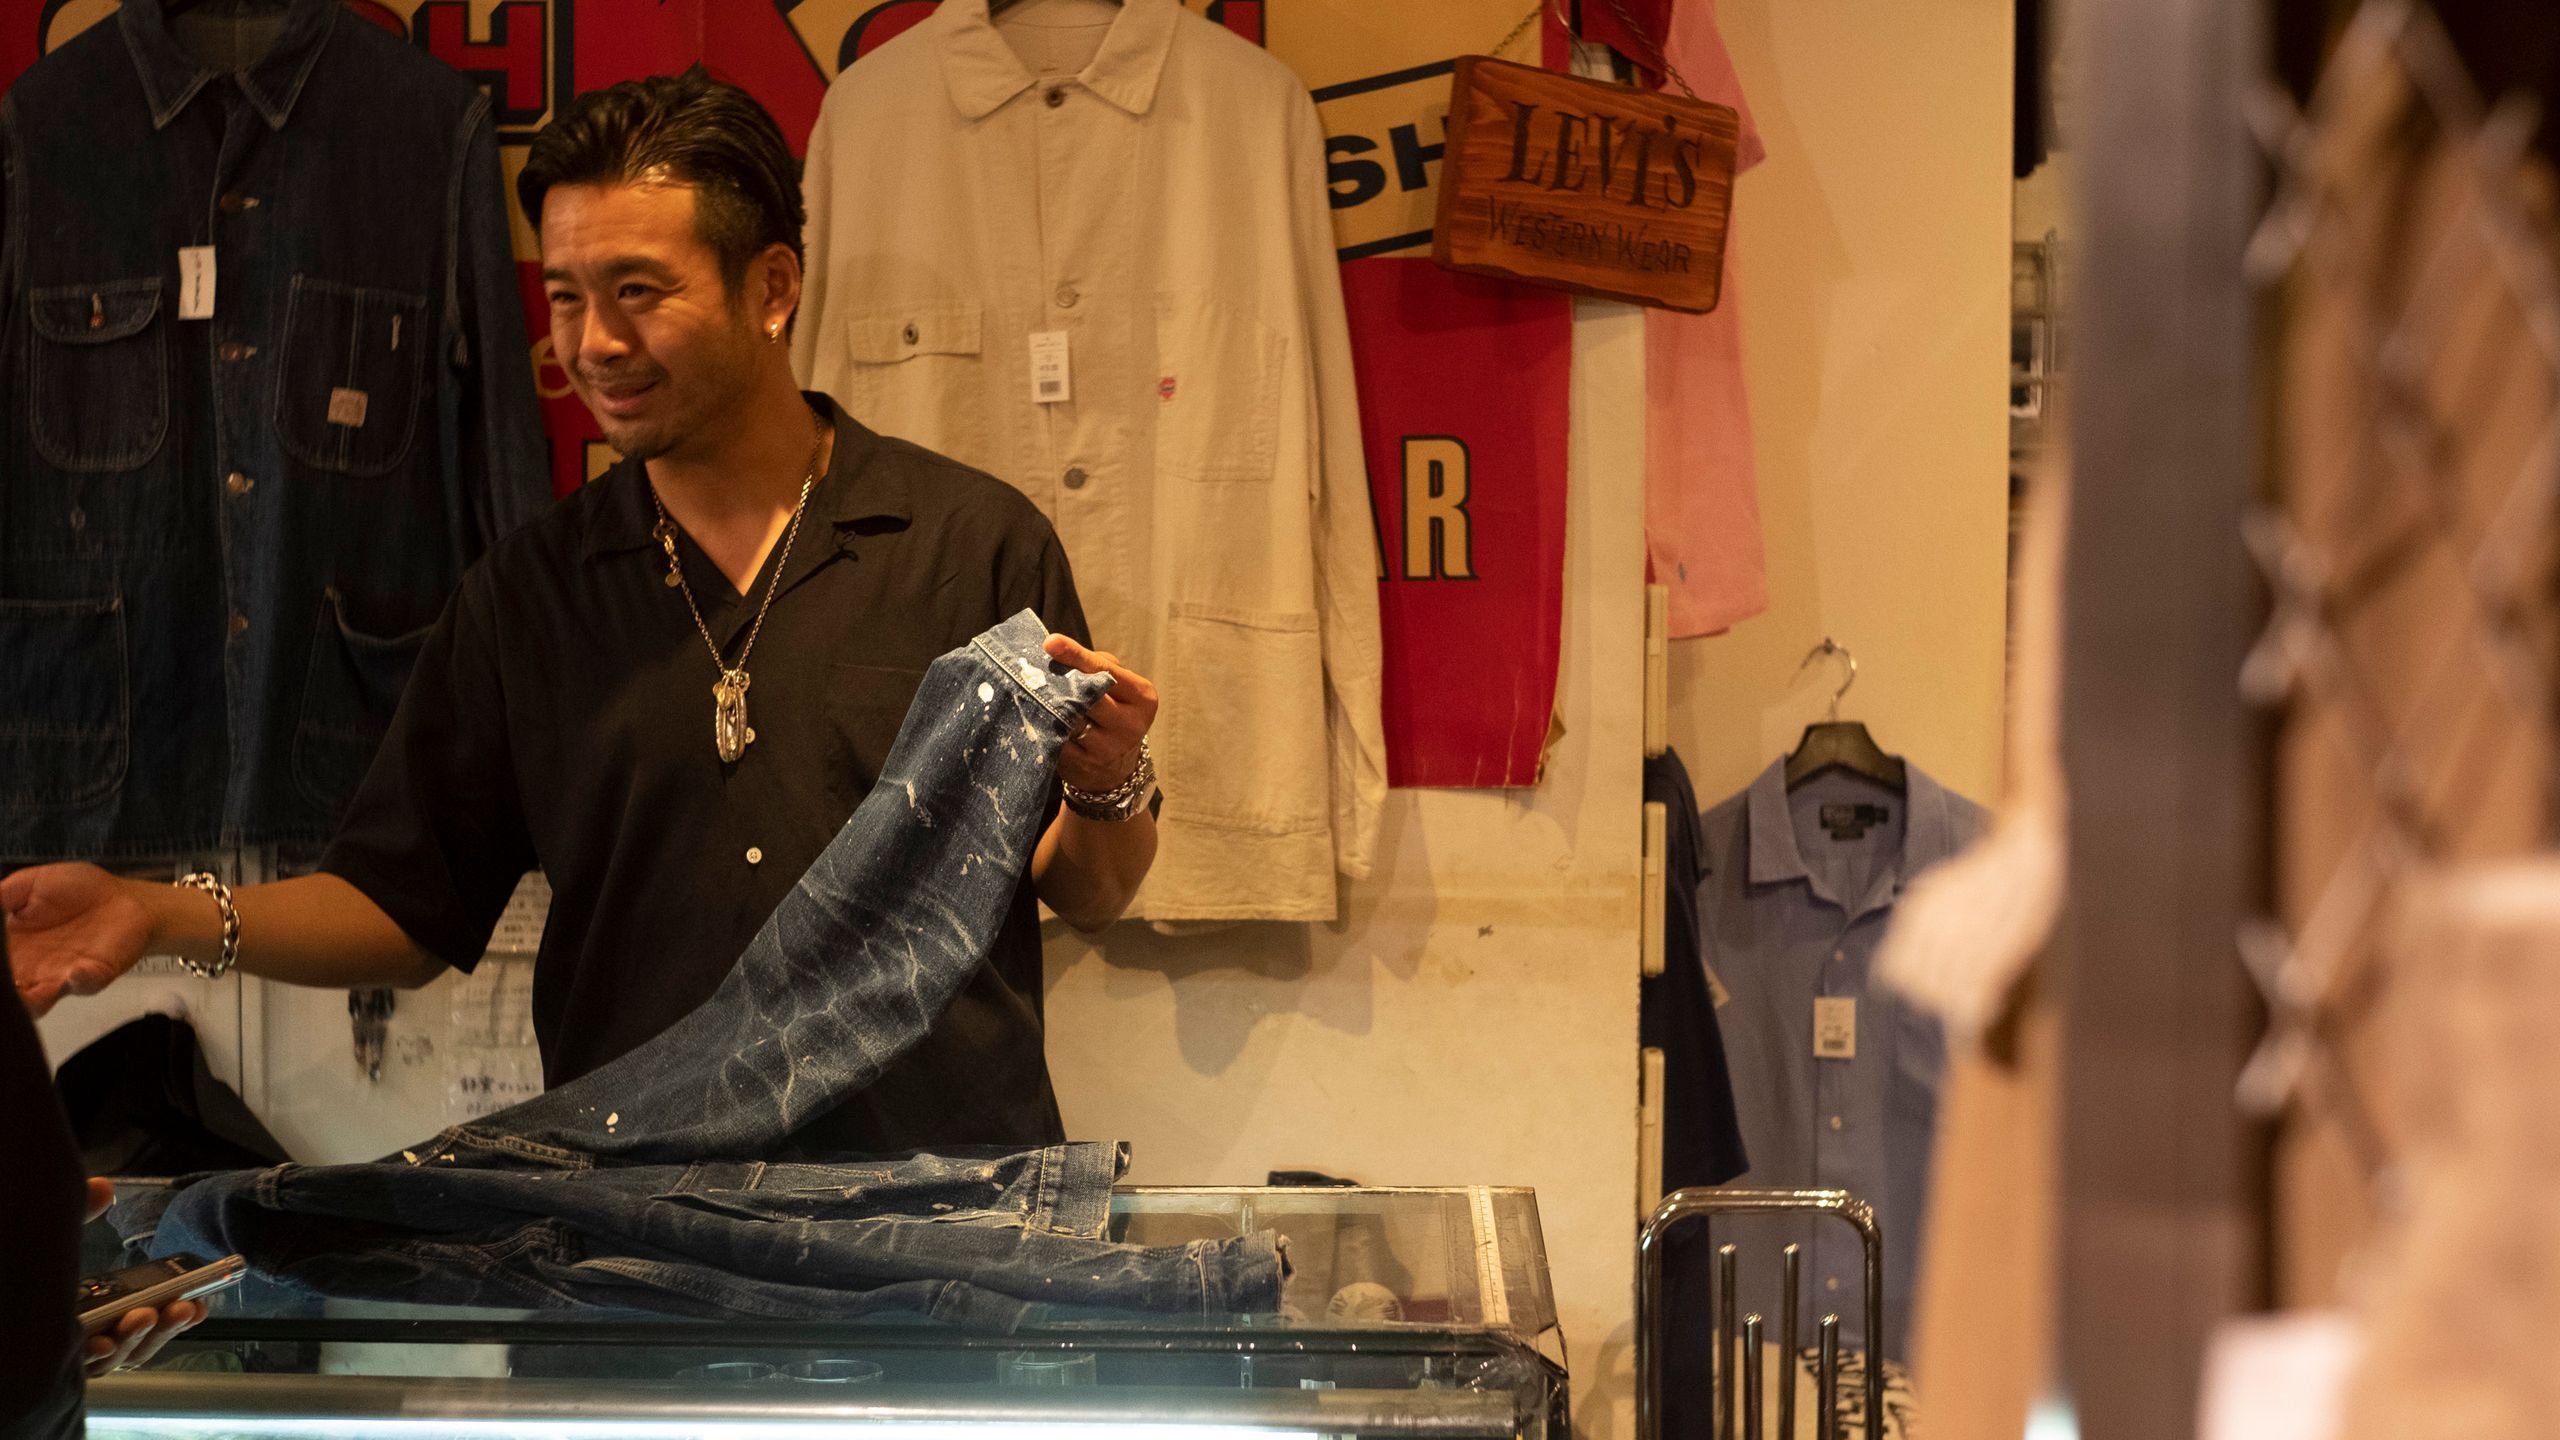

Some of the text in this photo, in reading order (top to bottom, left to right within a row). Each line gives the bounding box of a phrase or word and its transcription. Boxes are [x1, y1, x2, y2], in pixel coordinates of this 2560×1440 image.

[1497, 101, 1701, 213] LEVI'S
[1489, 197, 1691, 273] WESTERN WEAR
[1368, 433, 1480, 582] R
